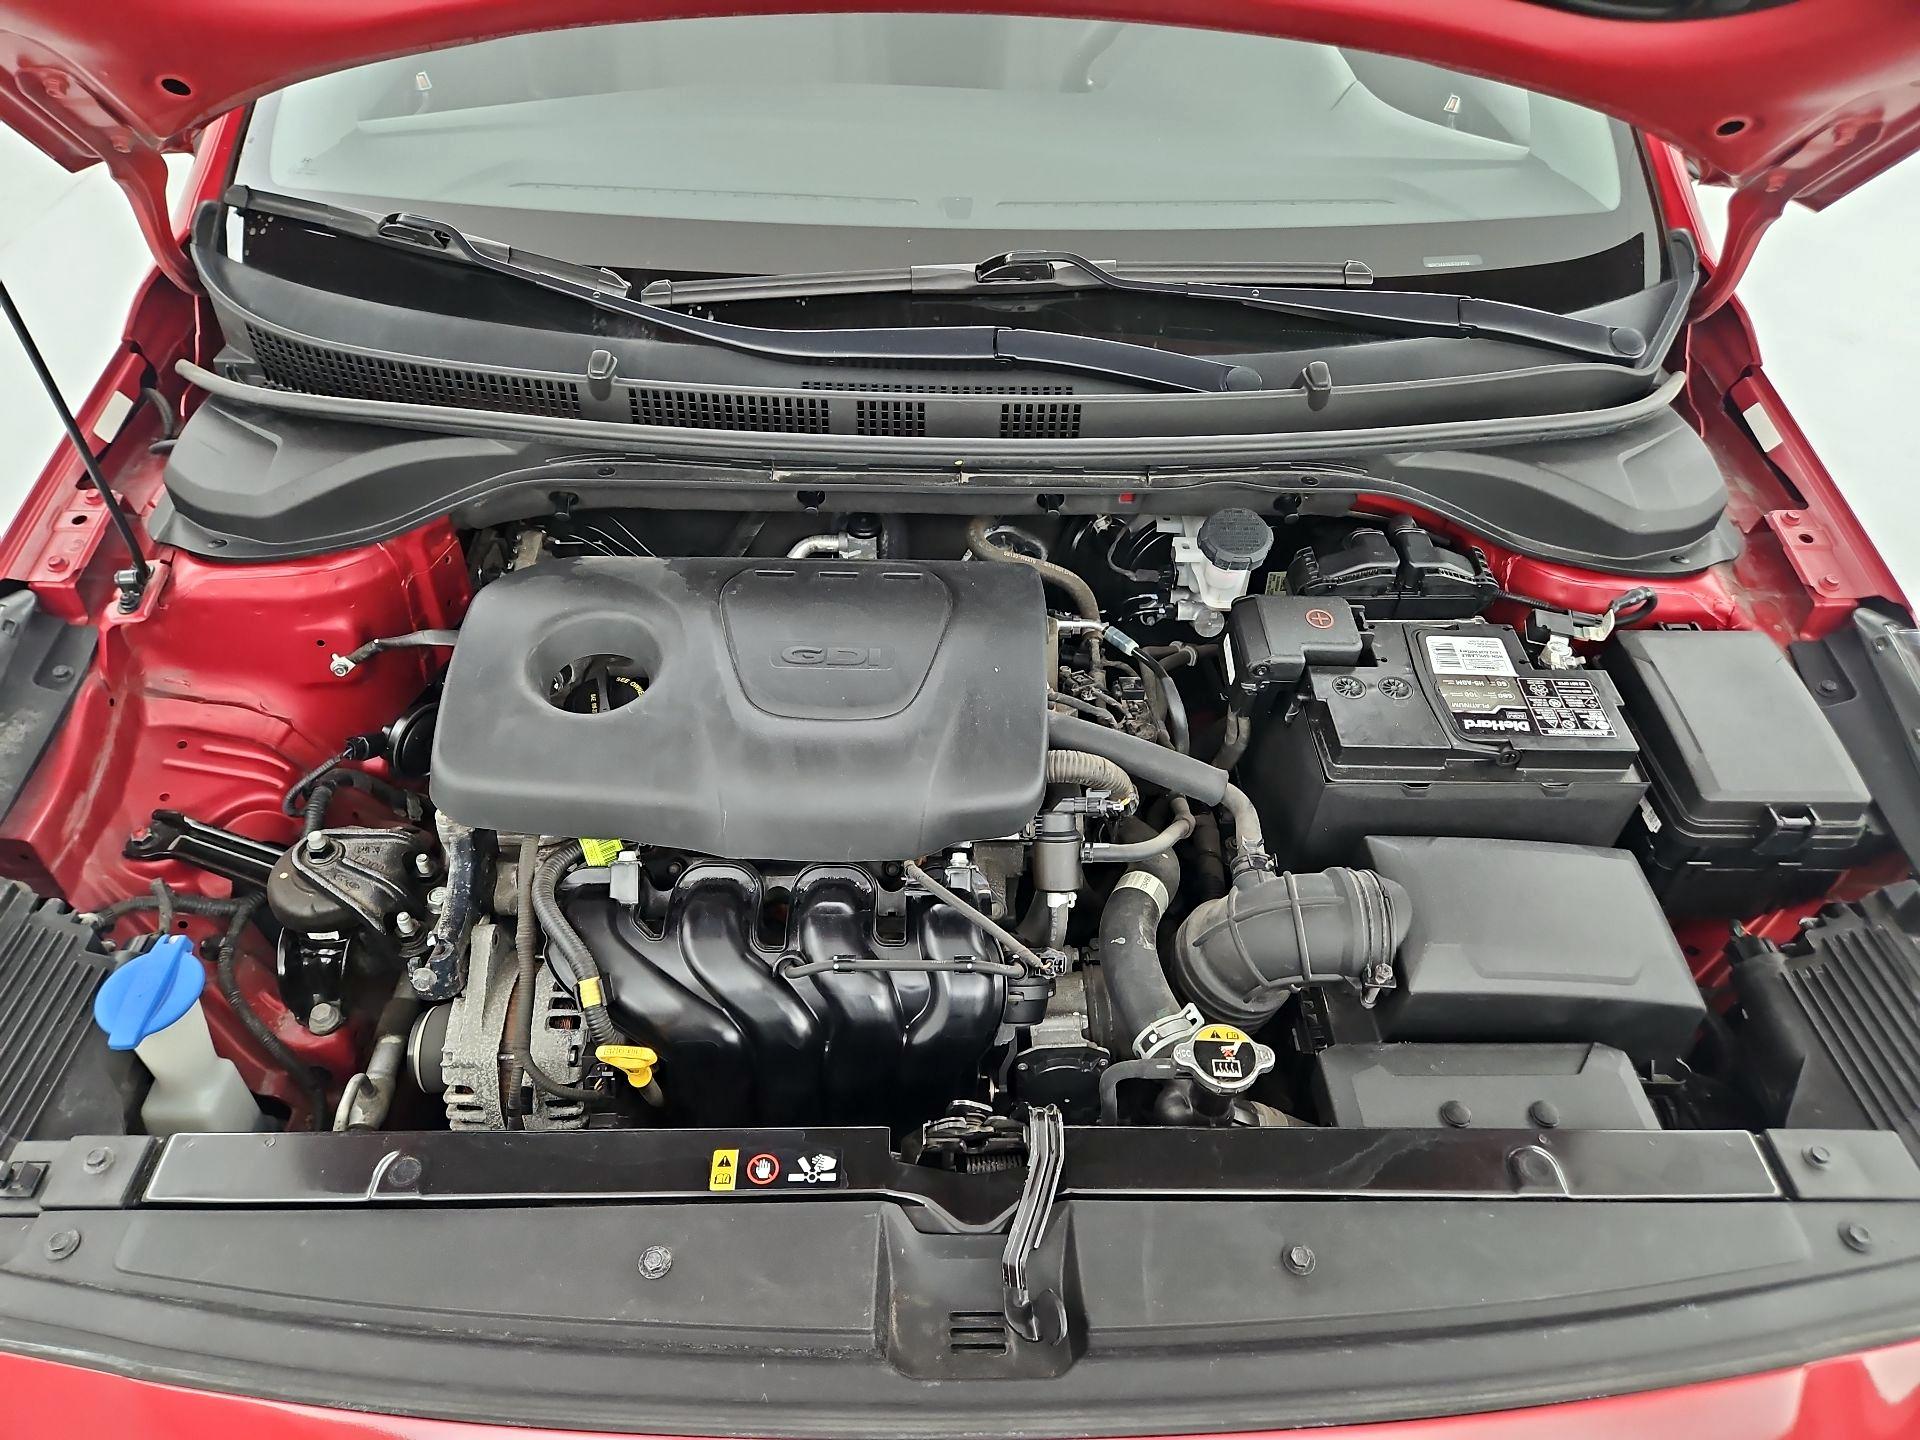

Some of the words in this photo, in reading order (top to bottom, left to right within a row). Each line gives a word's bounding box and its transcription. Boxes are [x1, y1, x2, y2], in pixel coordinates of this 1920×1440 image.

[781, 645, 881, 666] GDI
[1463, 719, 1531, 732] DieHard
[1176, 1049, 1192, 1057] HCC
